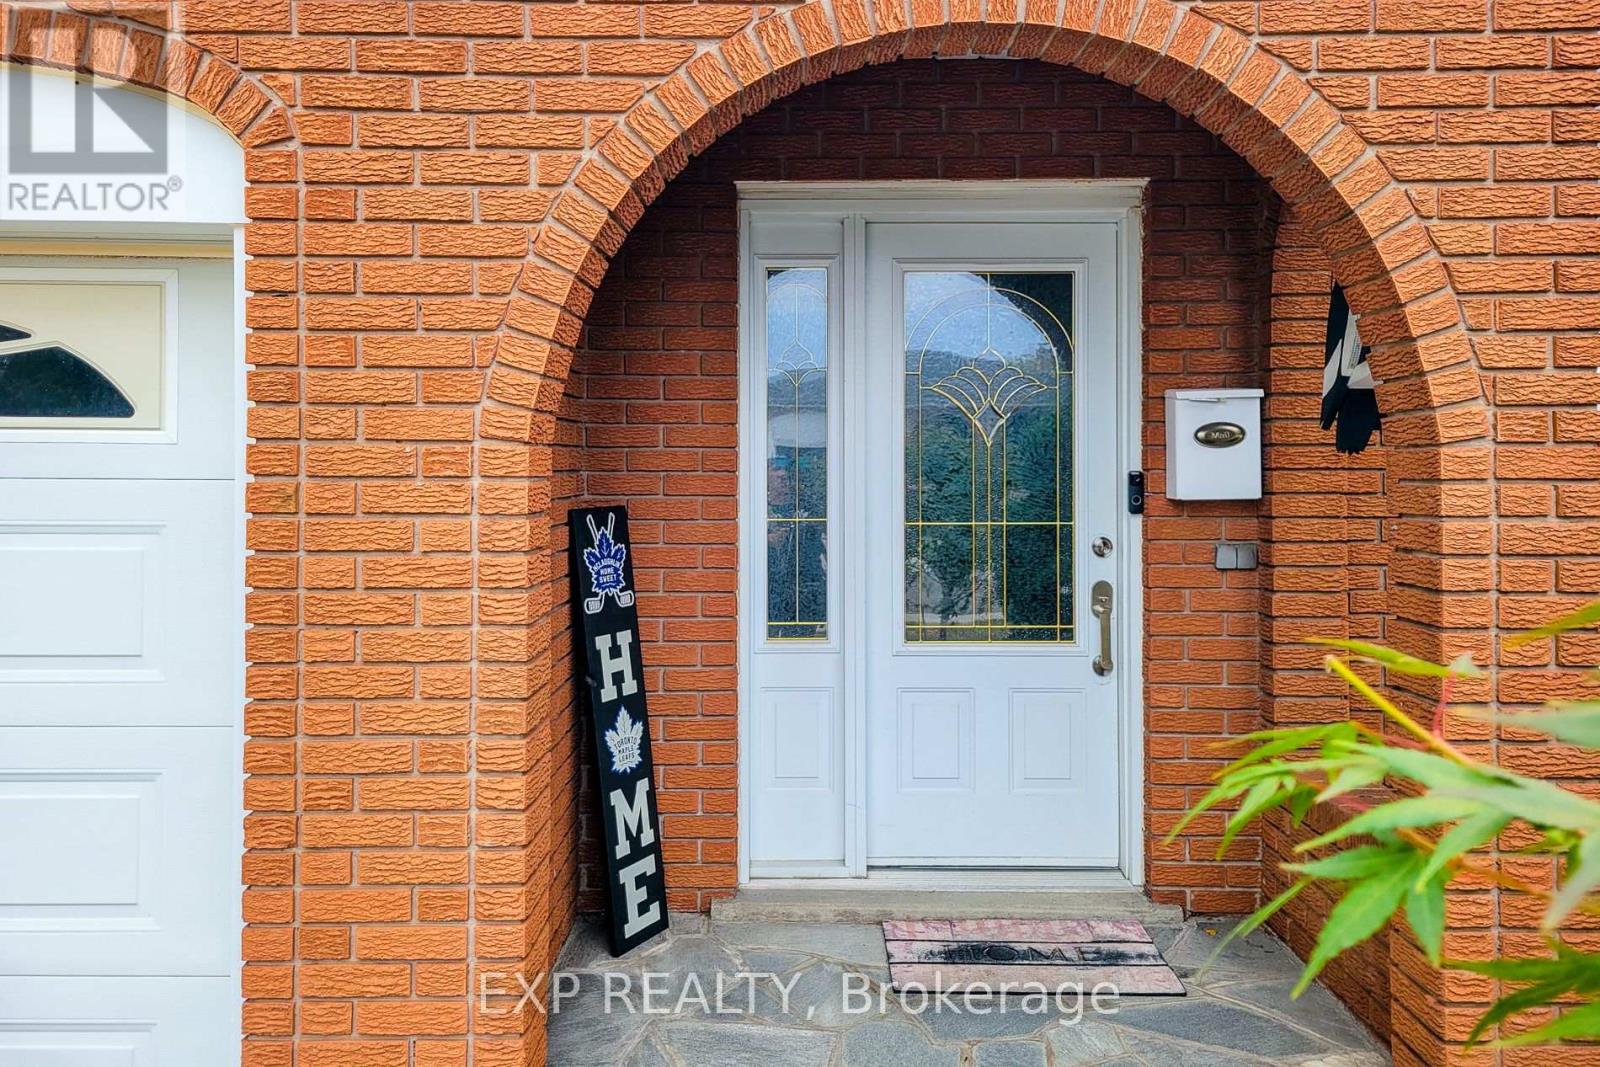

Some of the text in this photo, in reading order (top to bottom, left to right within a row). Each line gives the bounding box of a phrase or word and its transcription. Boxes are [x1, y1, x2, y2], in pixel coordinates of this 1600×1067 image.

[1211, 430, 1231, 439] Mail
[614, 736, 637, 749] TORONTO
[618, 752, 635, 762] LEAFS
